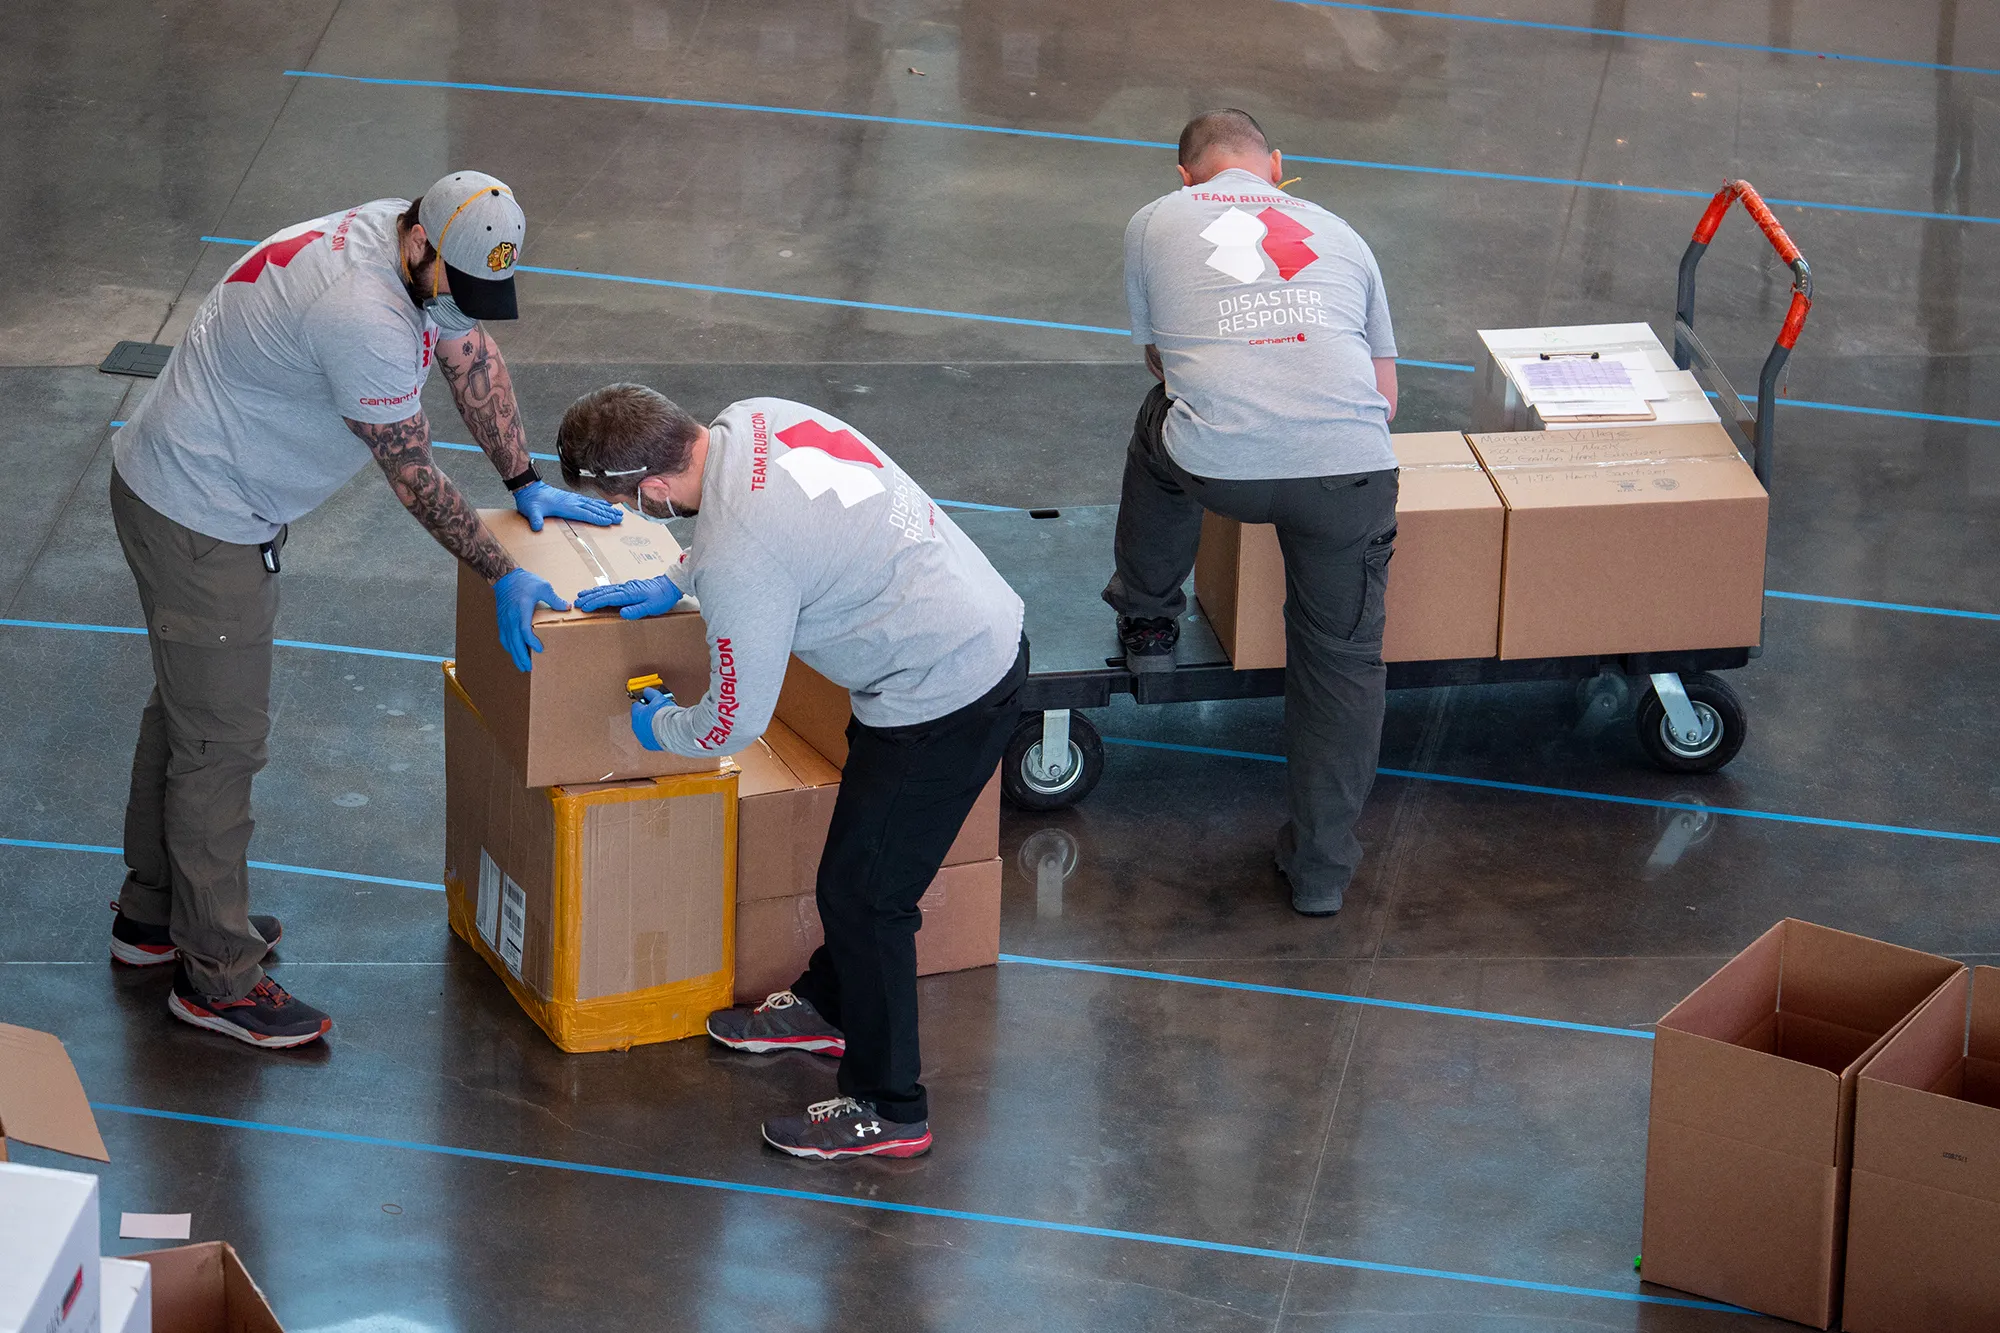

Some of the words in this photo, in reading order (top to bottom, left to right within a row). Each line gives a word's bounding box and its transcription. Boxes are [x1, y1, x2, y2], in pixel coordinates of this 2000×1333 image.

[1191, 193, 1236, 203] TEAM
[1219, 289, 1322, 316] DISASTER
[1218, 307, 1329, 335] RESPONSE
[1248, 337, 1296, 345] carhartt
[360, 392, 413, 406] carhartt
[751, 412, 767, 454] RUBICON
[751, 457, 767, 491] TEAM
[716, 638, 740, 718] RUBICON
